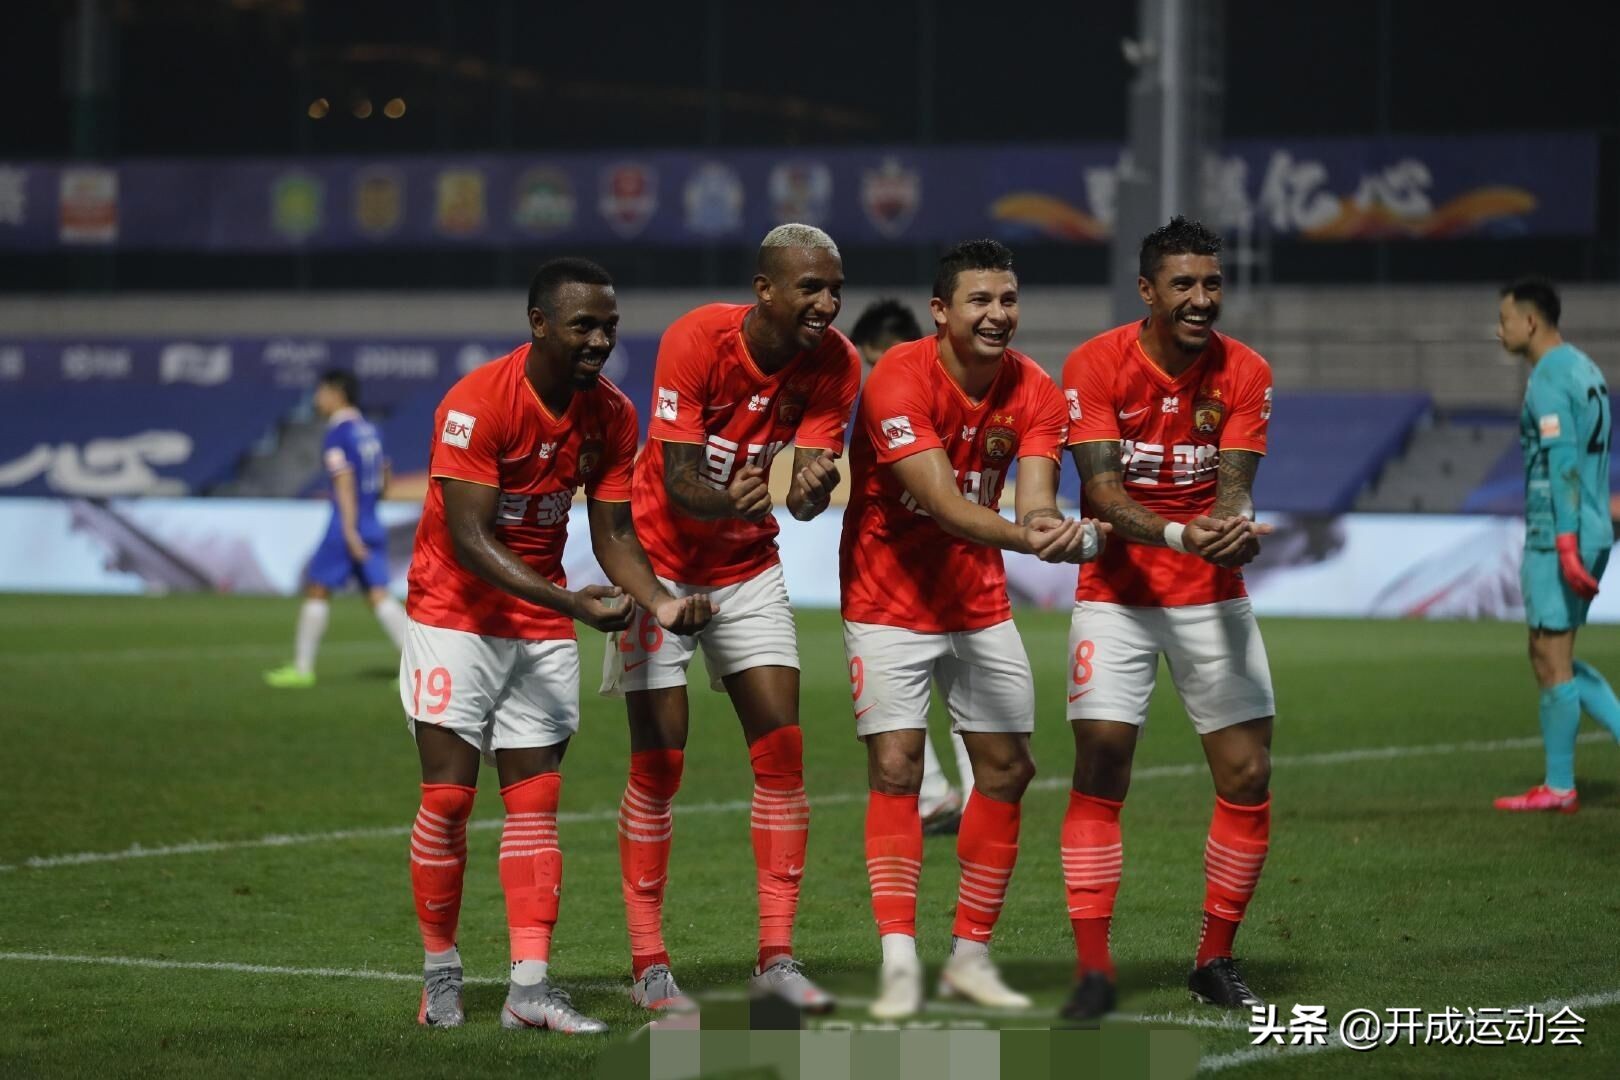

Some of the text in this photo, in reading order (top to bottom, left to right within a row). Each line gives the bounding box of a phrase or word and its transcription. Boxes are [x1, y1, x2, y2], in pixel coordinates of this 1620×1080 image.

[850, 655, 865, 702] 9
[1072, 639, 1096, 686] 8
[413, 666, 453, 716] 19
